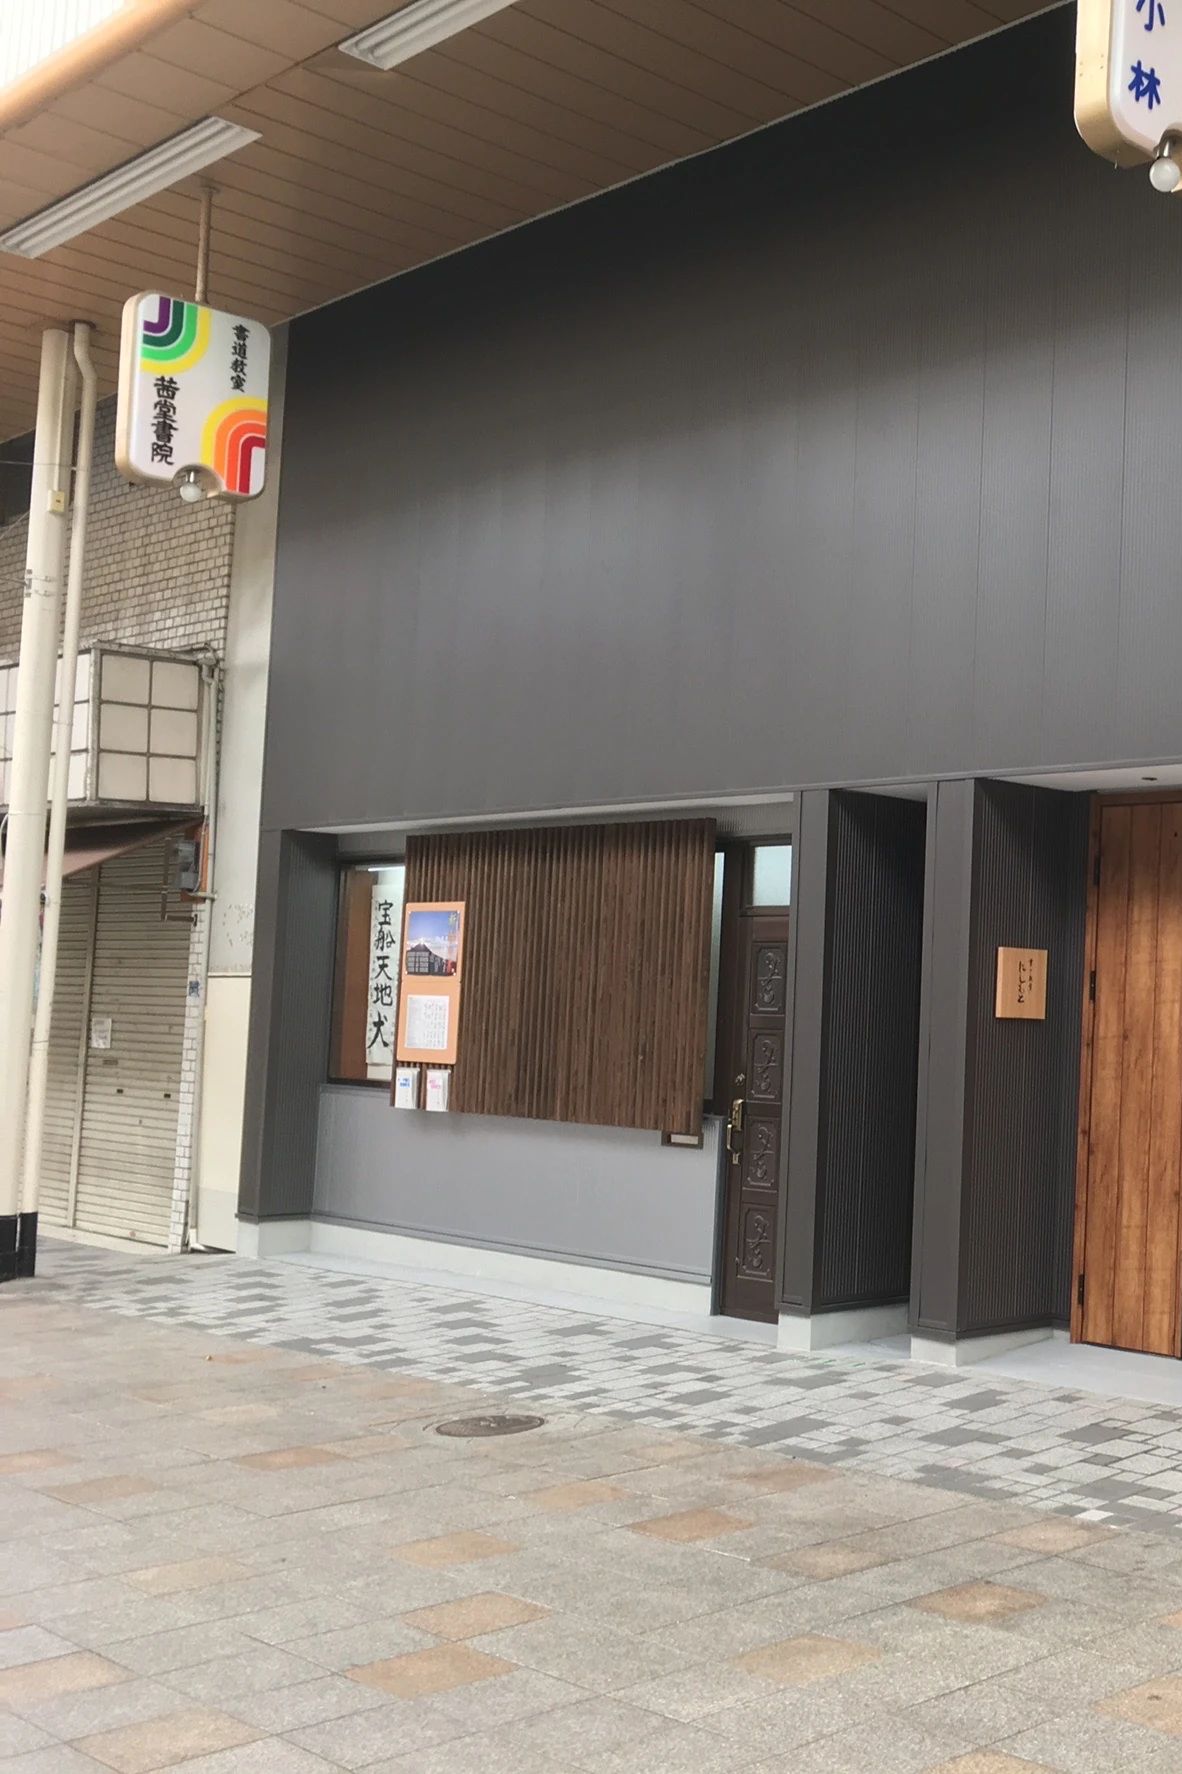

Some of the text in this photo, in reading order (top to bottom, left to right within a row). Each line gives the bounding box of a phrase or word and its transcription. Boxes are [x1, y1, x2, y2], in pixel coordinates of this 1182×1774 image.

[229, 323, 250, 393] 書道教室
[150, 375, 180, 466] 茜堂書院
